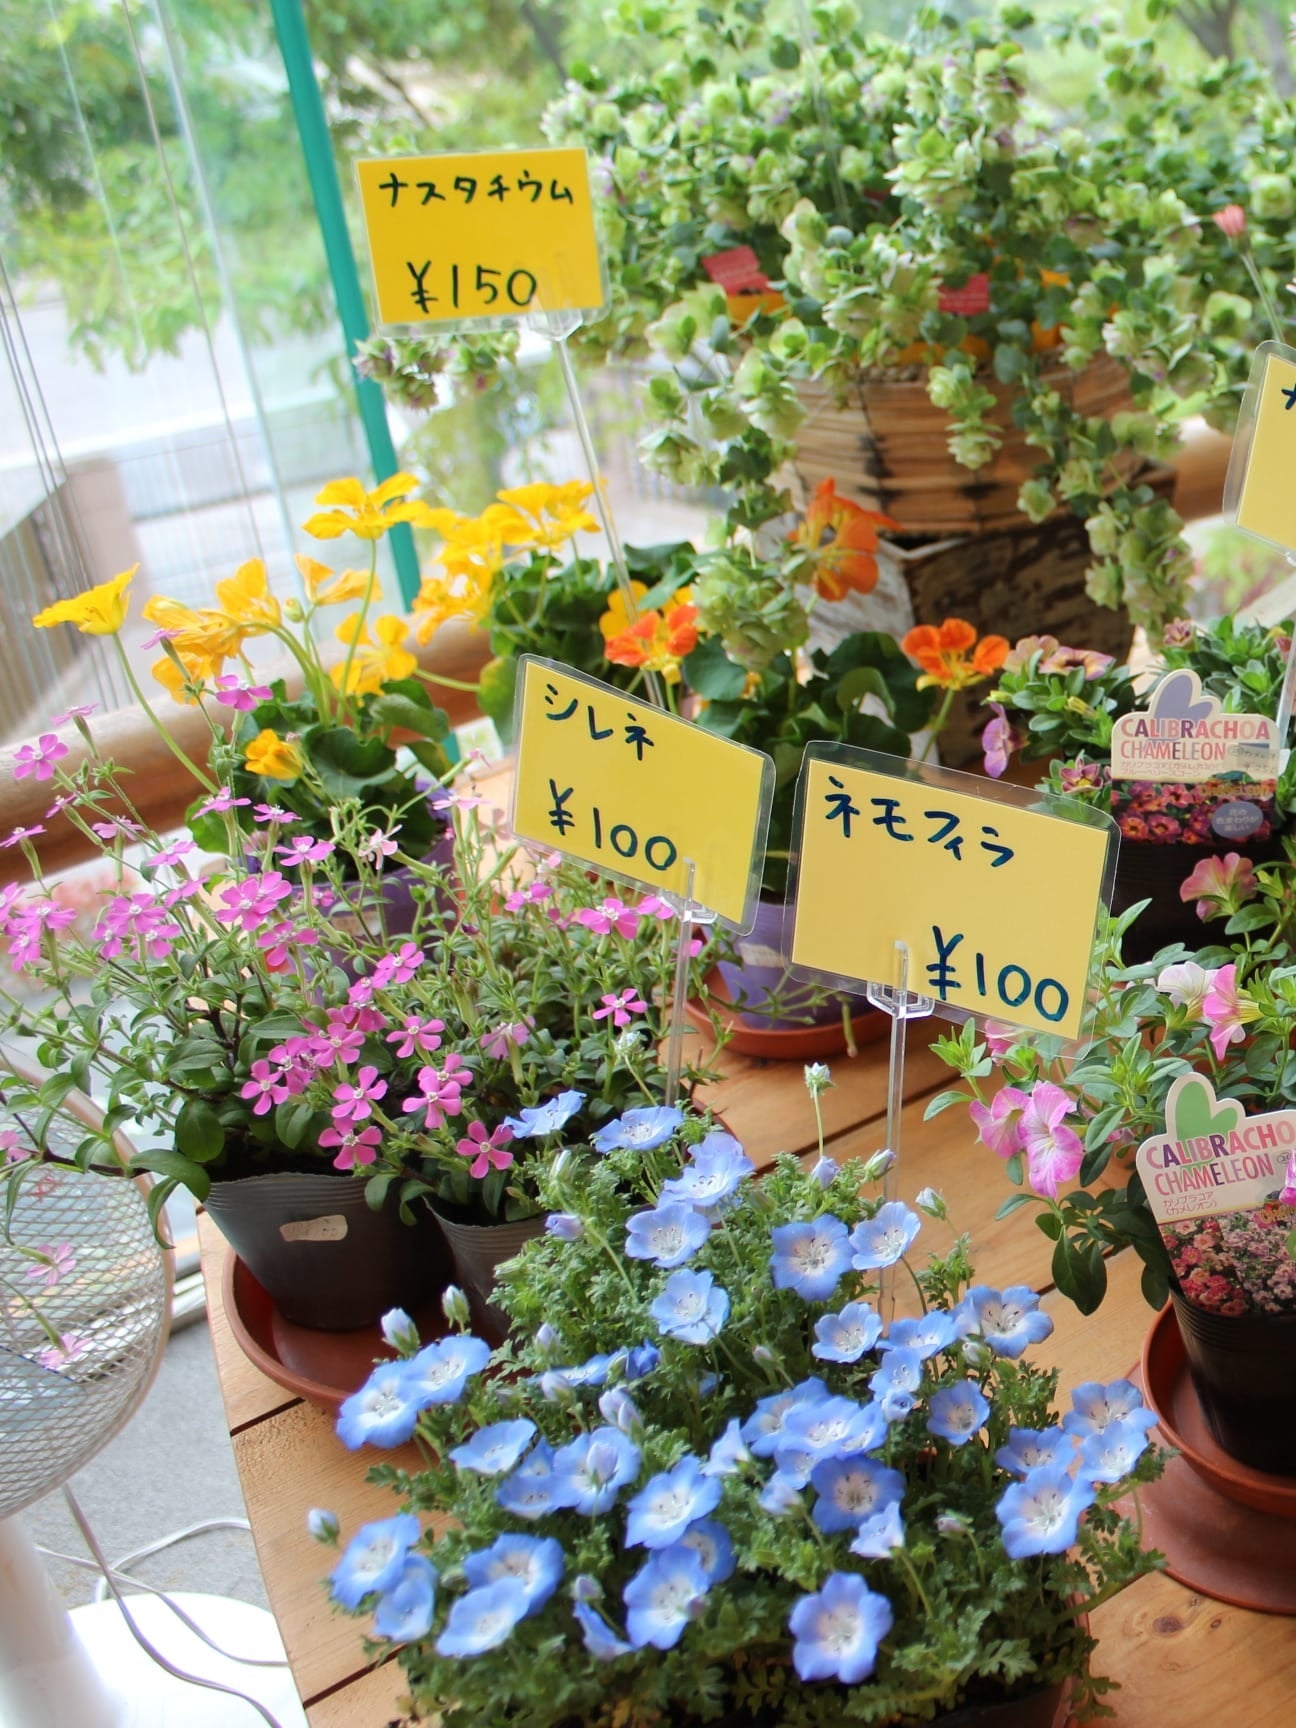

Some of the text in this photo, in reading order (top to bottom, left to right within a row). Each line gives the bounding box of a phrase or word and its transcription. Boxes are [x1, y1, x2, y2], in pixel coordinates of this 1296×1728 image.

[379, 170, 574, 207] ナスタチウム
[406, 260, 537, 314] ¥150
[544, 684, 655, 761] シレネ
[1120, 718, 1270, 740] CALIBRACHOA
[1120, 741, 1226, 761] CHAMELEON
[548, 778, 678, 871] ¥100
[824, 776, 1014, 867] ネモフィラ
[926, 925, 1069, 1022] ¥100
[1154, 1153, 1274, 1197] CHAMELEON
